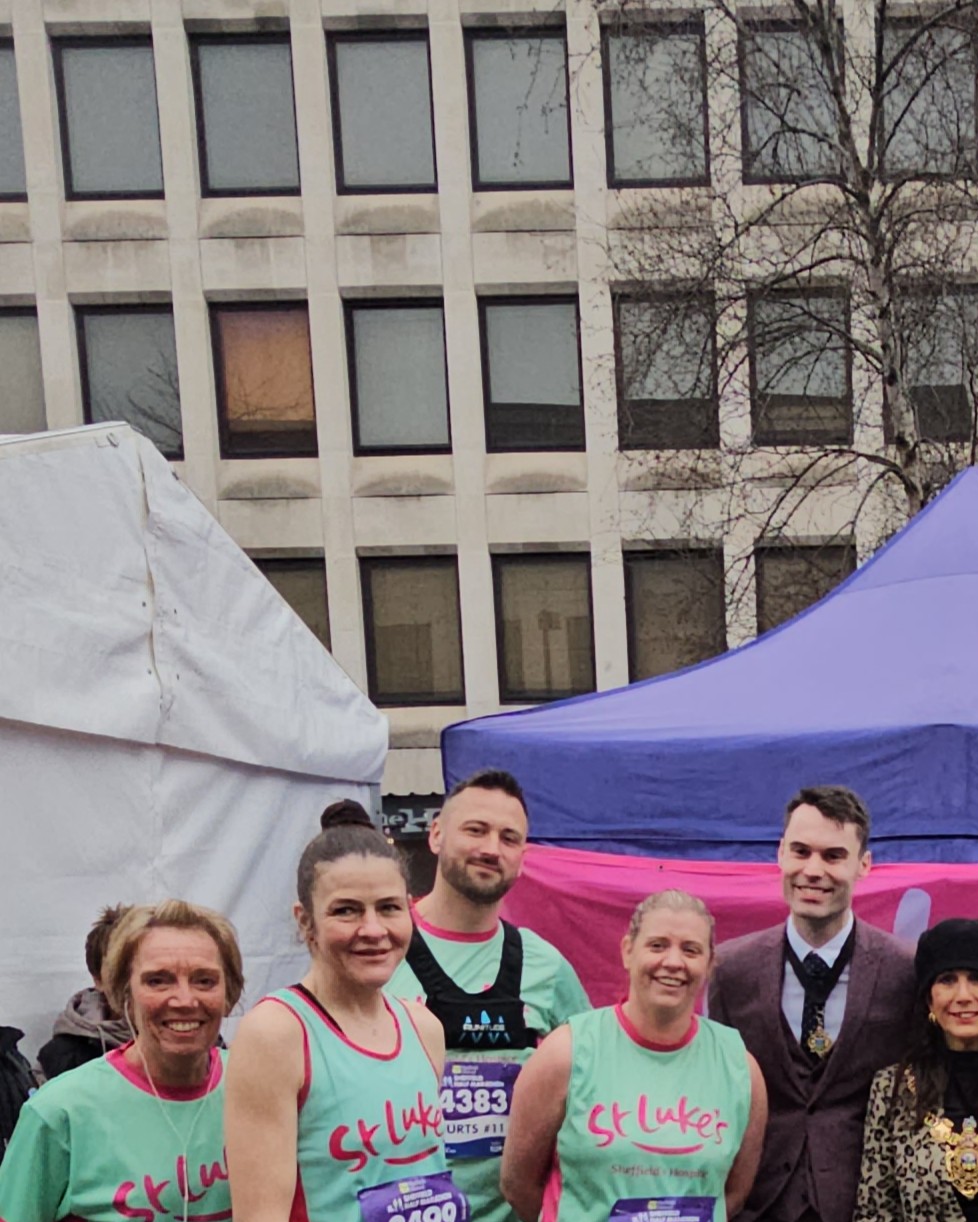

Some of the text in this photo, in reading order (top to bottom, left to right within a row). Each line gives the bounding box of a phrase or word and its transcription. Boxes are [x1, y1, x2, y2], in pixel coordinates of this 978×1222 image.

[439, 1088, 508, 1114] 4383
[587, 1093, 729, 1148] St Luke's
[328, 1090, 445, 1173] St Luke
